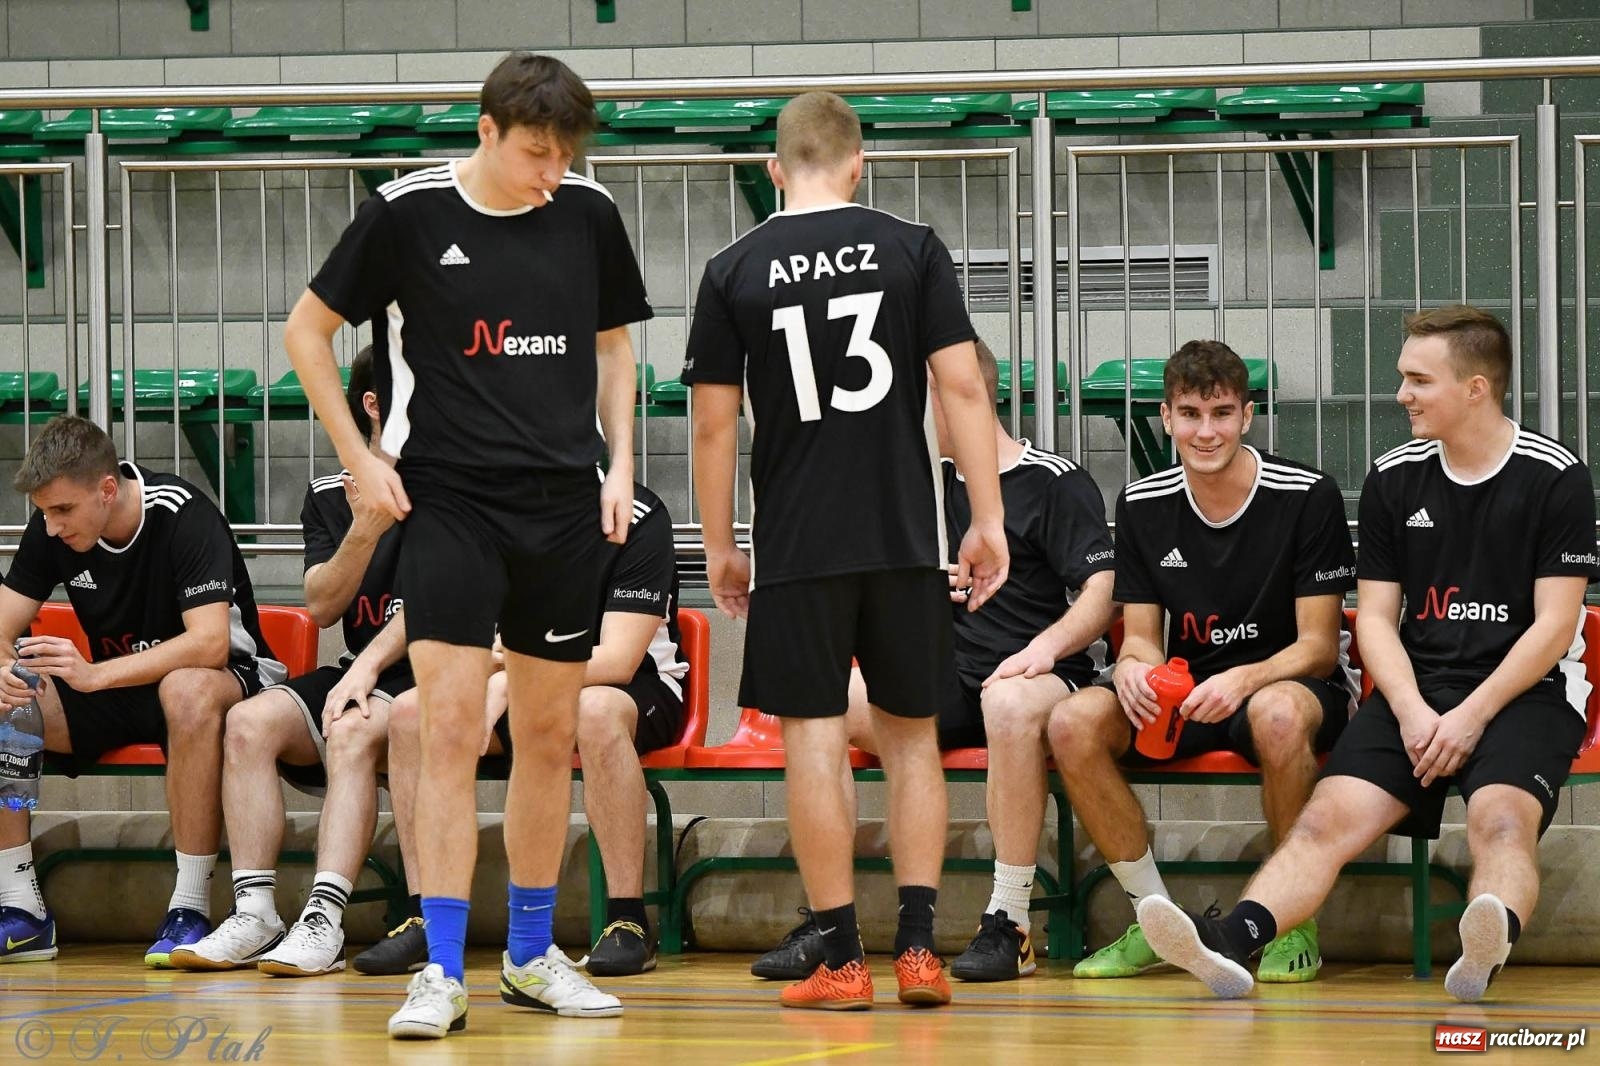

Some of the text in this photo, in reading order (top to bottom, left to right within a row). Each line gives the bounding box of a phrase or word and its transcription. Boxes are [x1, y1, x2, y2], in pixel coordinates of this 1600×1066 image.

[768, 243, 879, 288] APACZ
[463, 319, 567, 357] Nexans
[771, 290, 894, 423] 13
[70, 580, 97, 590] adidas
[613, 587, 661, 602] tkcandle.pl
